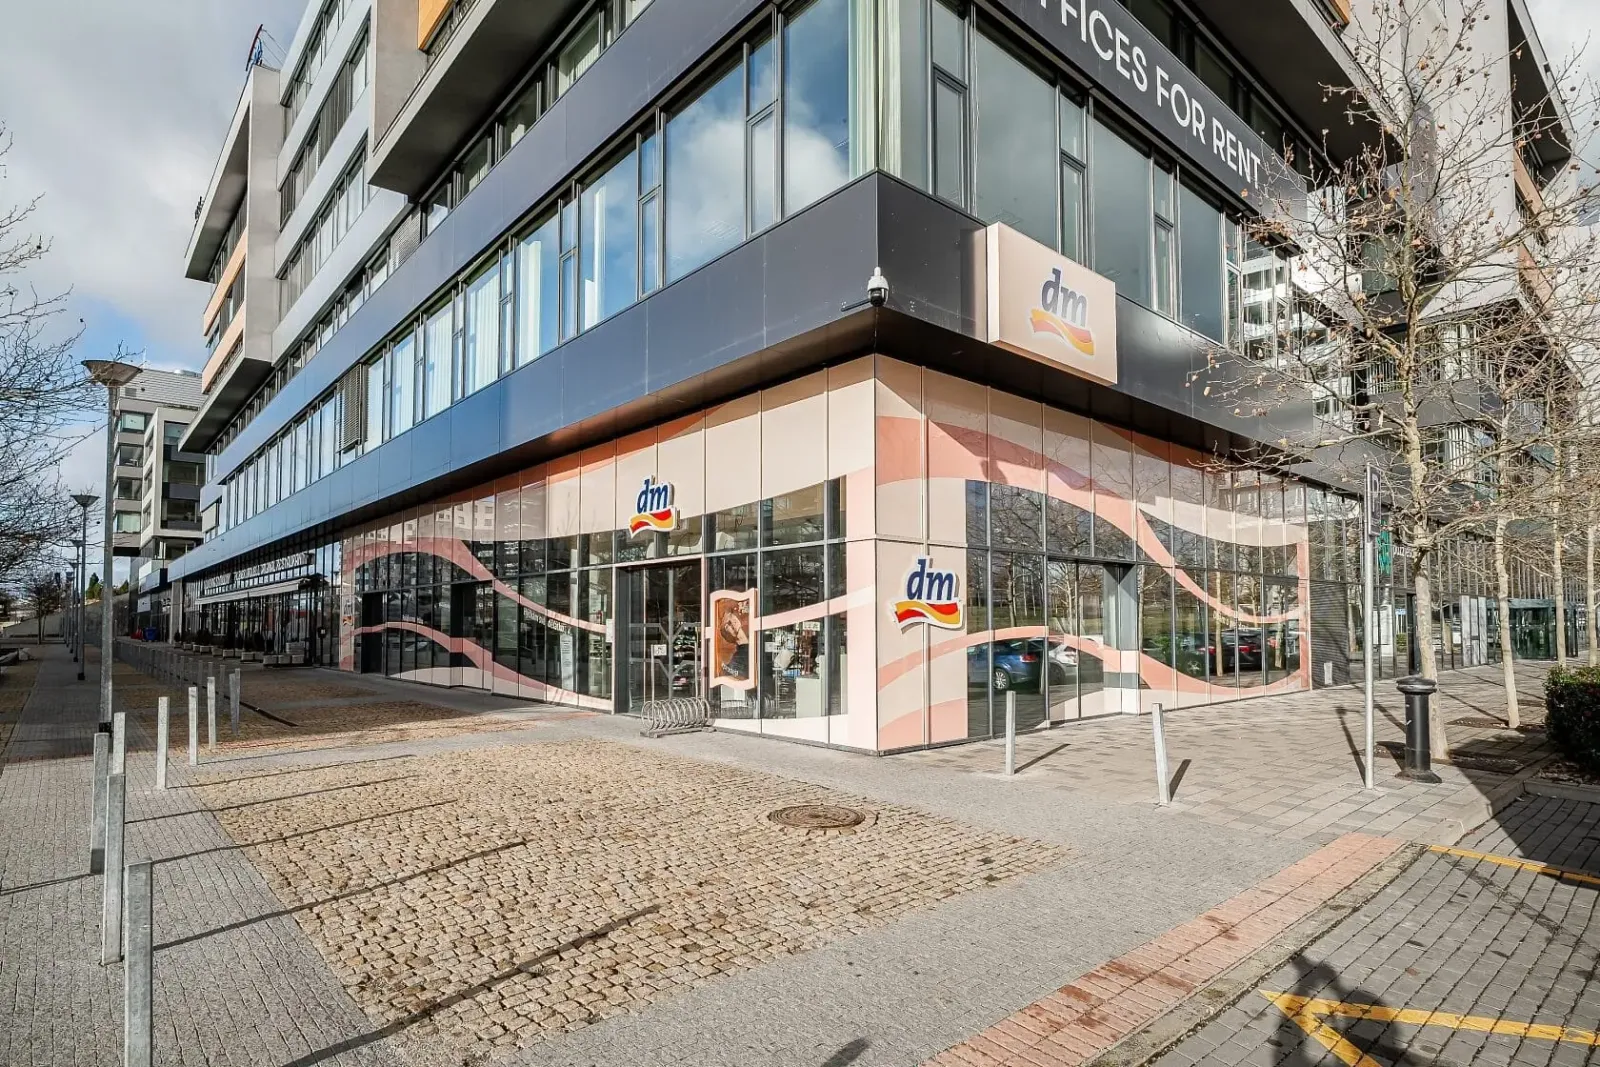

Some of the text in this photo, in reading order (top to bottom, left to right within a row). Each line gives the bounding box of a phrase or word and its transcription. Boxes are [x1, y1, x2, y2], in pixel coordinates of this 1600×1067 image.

[1040, 0, 1261, 189] FICES FOR RENT
[1041, 267, 1087, 328] dm
[636, 478, 669, 514] dm
[906, 558, 954, 600] dm
